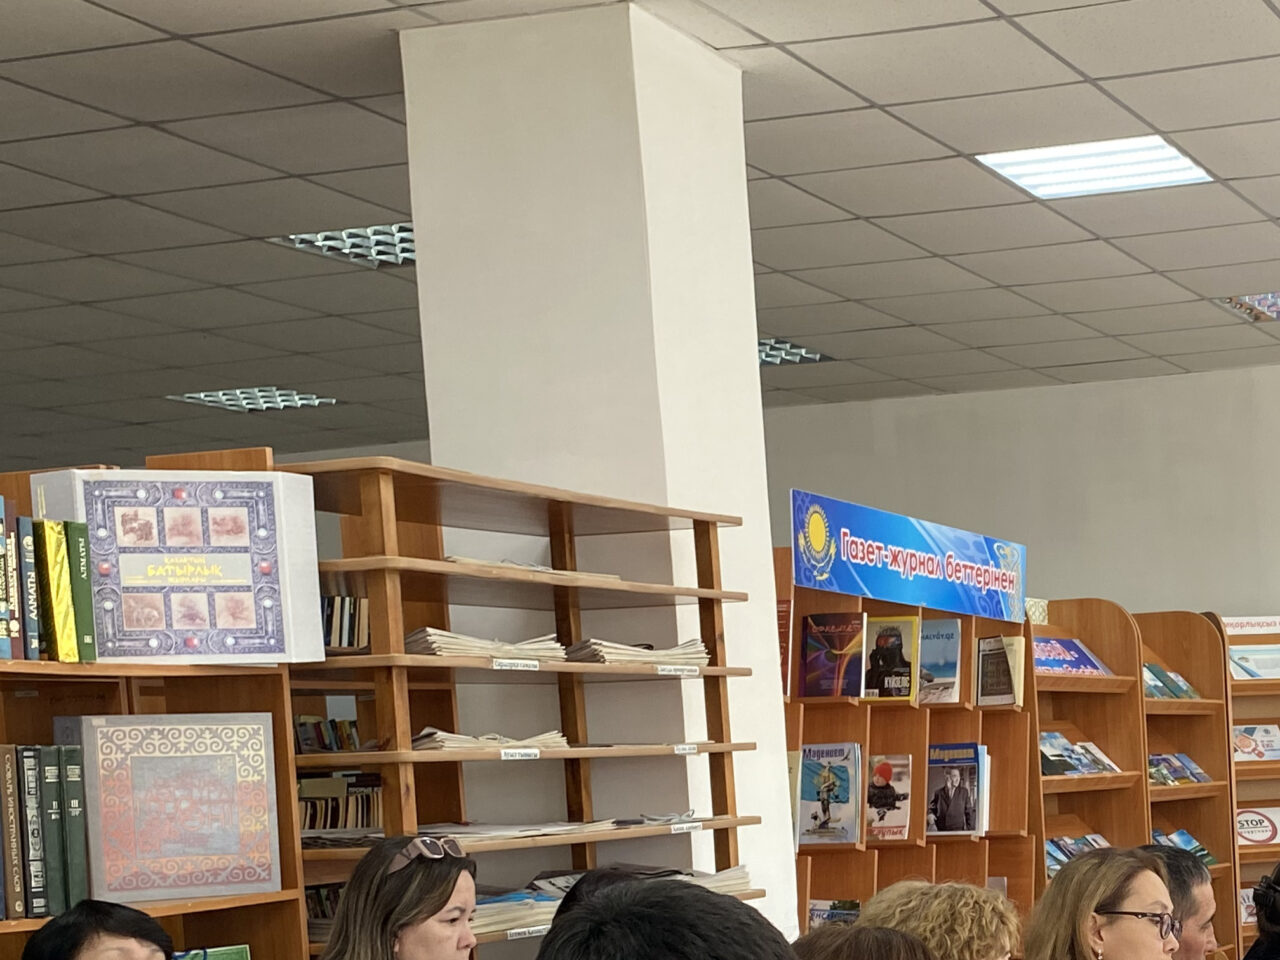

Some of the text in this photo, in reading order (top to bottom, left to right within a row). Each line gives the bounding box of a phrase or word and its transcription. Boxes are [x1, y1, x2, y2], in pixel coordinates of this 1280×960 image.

[841, 529, 1016, 593] Газет-журнал беттерінен
[27, 571, 38, 620] АЛМАТЫ
[1237, 819, 1265, 828] STOP
